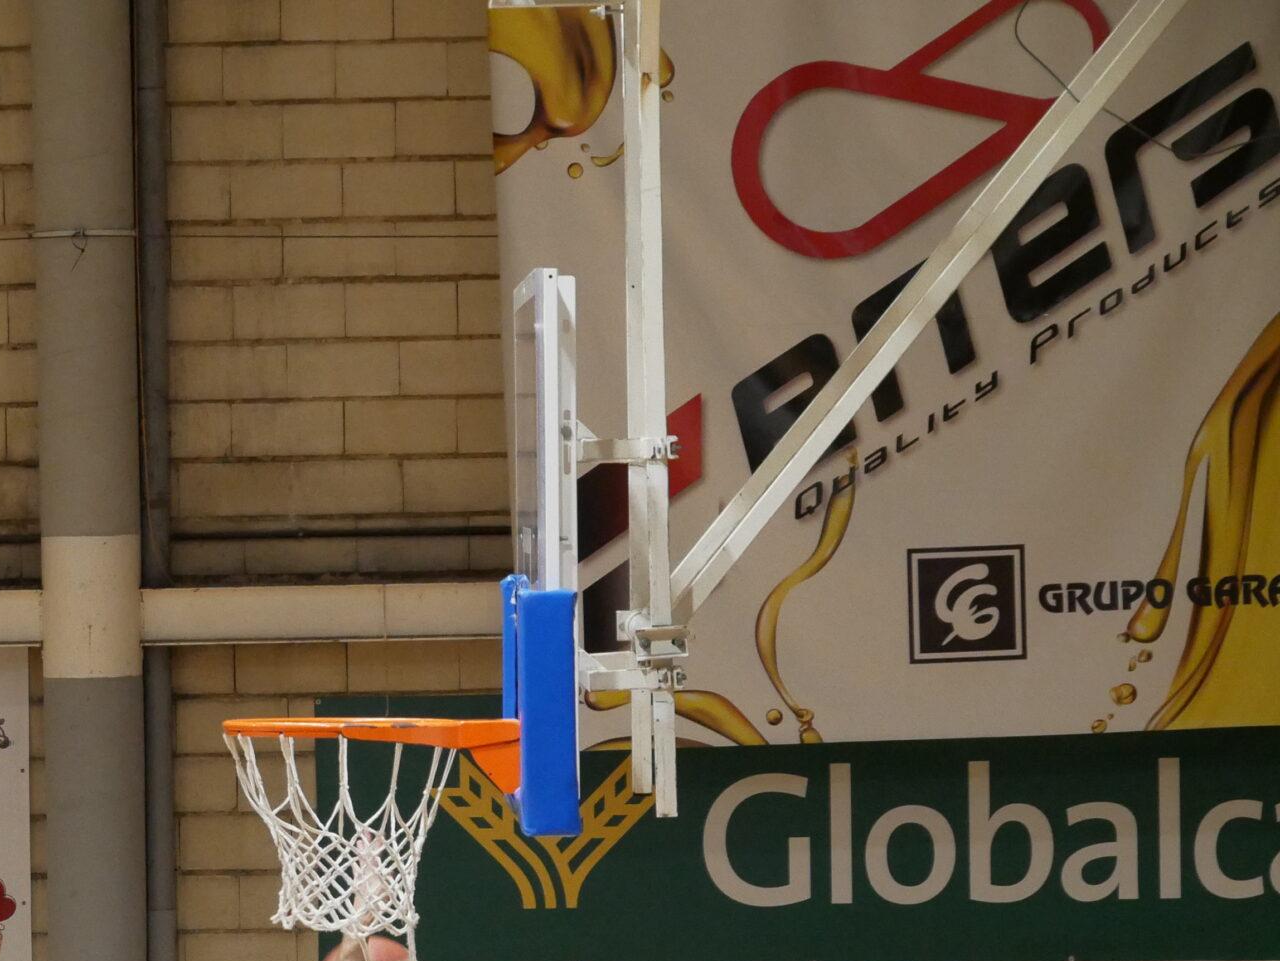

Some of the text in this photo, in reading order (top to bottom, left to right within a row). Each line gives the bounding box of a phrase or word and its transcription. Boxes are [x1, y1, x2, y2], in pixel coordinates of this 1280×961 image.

[1038, 573, 1280, 615] GRUPO GAR
[702, 757, 1280, 908] Globalc
